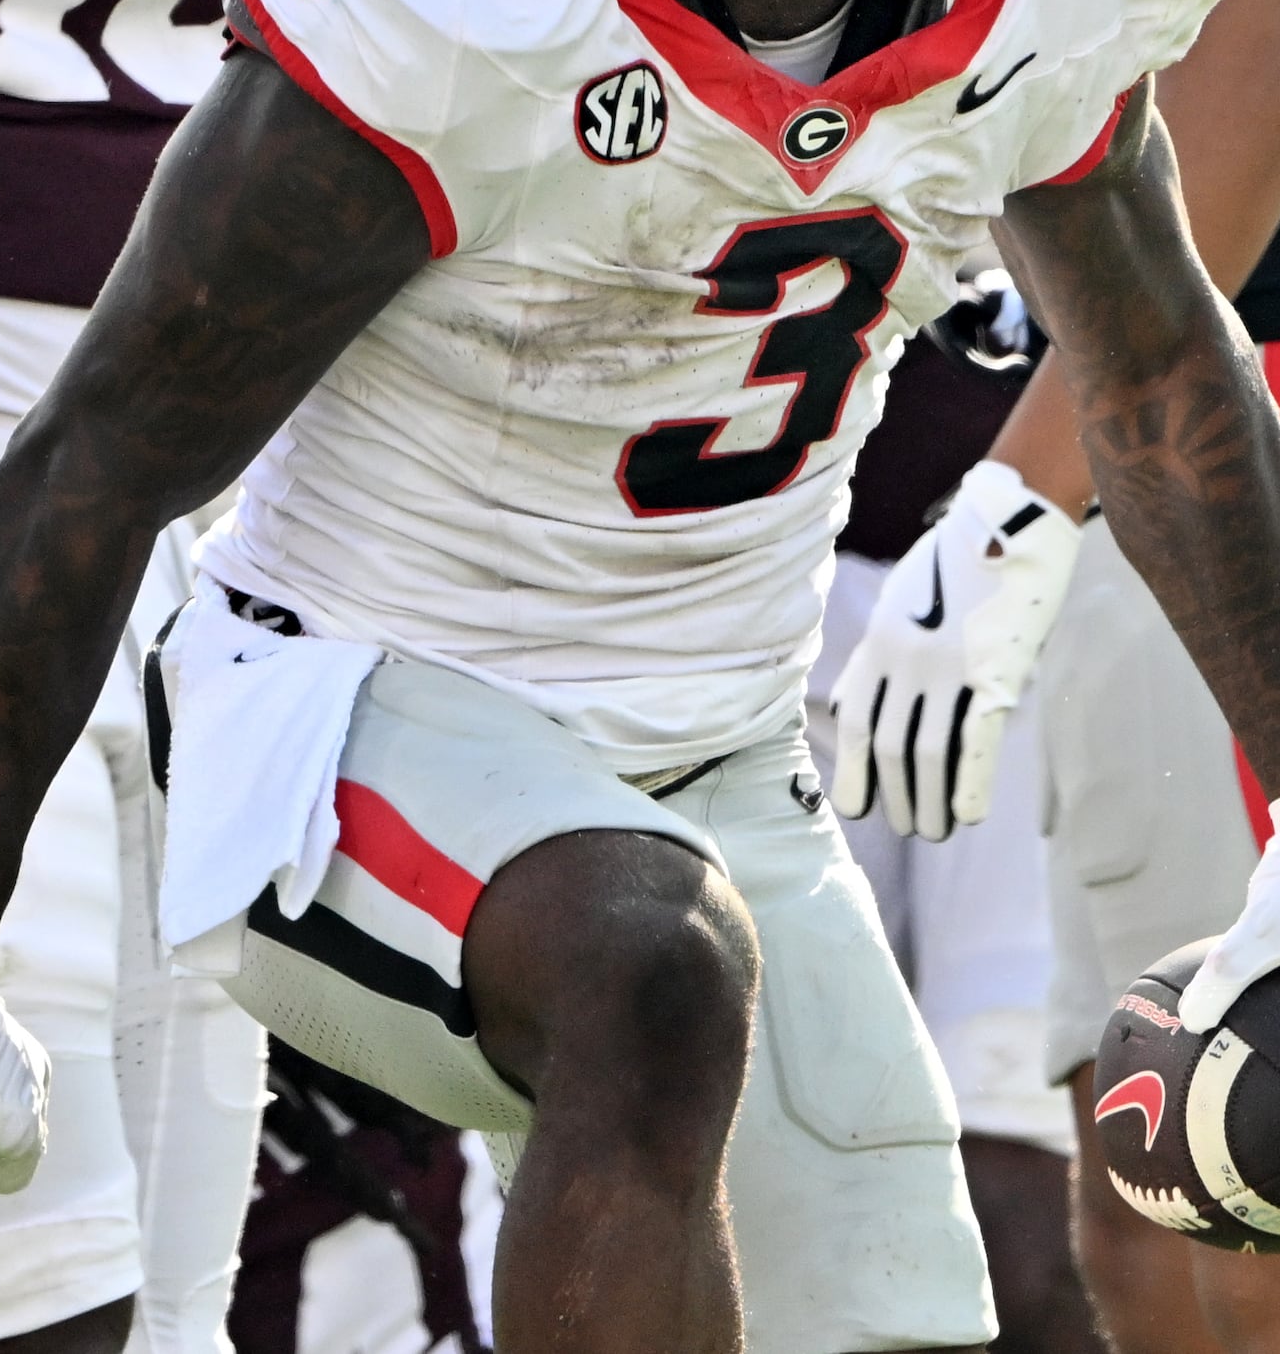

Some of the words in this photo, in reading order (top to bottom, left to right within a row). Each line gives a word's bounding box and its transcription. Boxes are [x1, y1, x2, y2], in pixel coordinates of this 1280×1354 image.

[578, 63, 667, 163] SEC
[783, 108, 850, 163] G
[614, 205, 910, 519] 3
